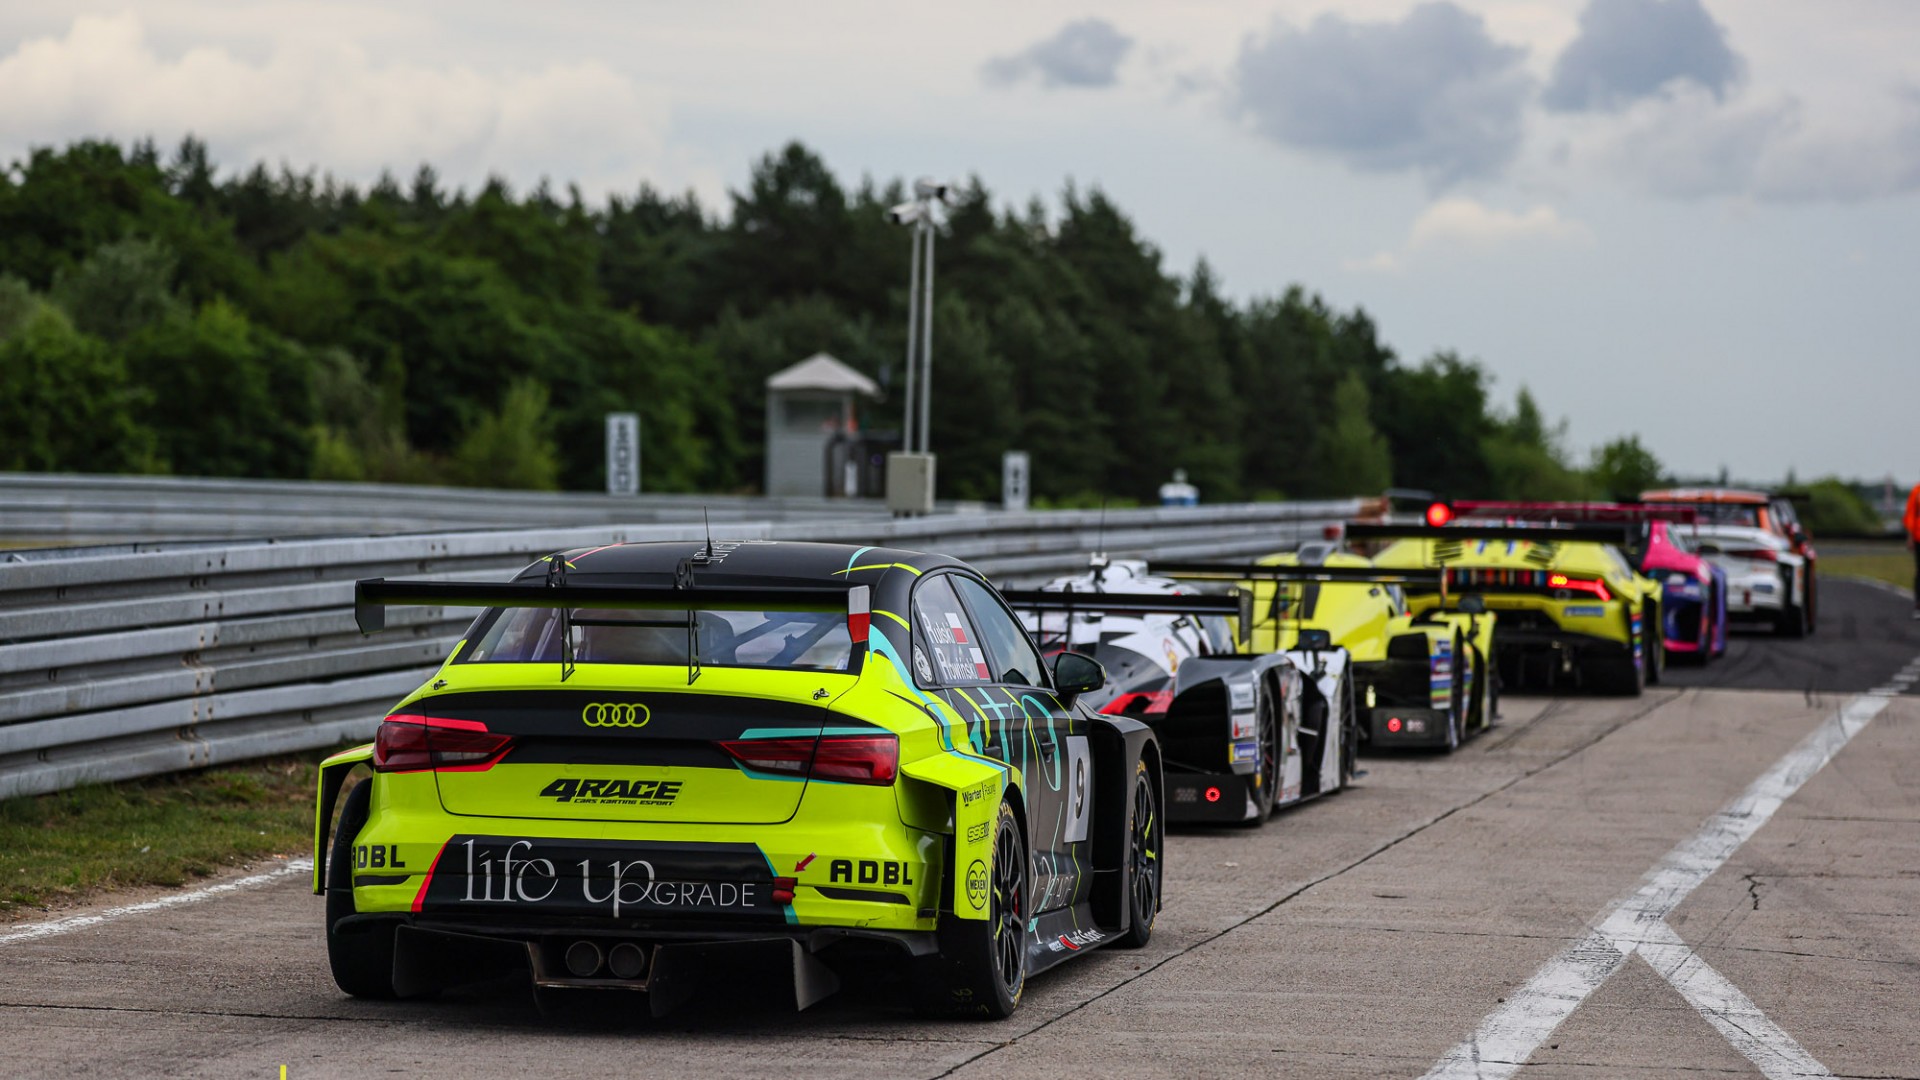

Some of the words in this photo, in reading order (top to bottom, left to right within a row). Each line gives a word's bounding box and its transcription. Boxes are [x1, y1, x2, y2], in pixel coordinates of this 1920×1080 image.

[921, 612, 956, 644] Rulski
[539, 778, 684, 802] 4RACE
[961, 789, 982, 804] Warter
[1075, 757, 1085, 819] 9
[459, 838, 559, 902] life
[830, 859, 913, 885] ADBL
